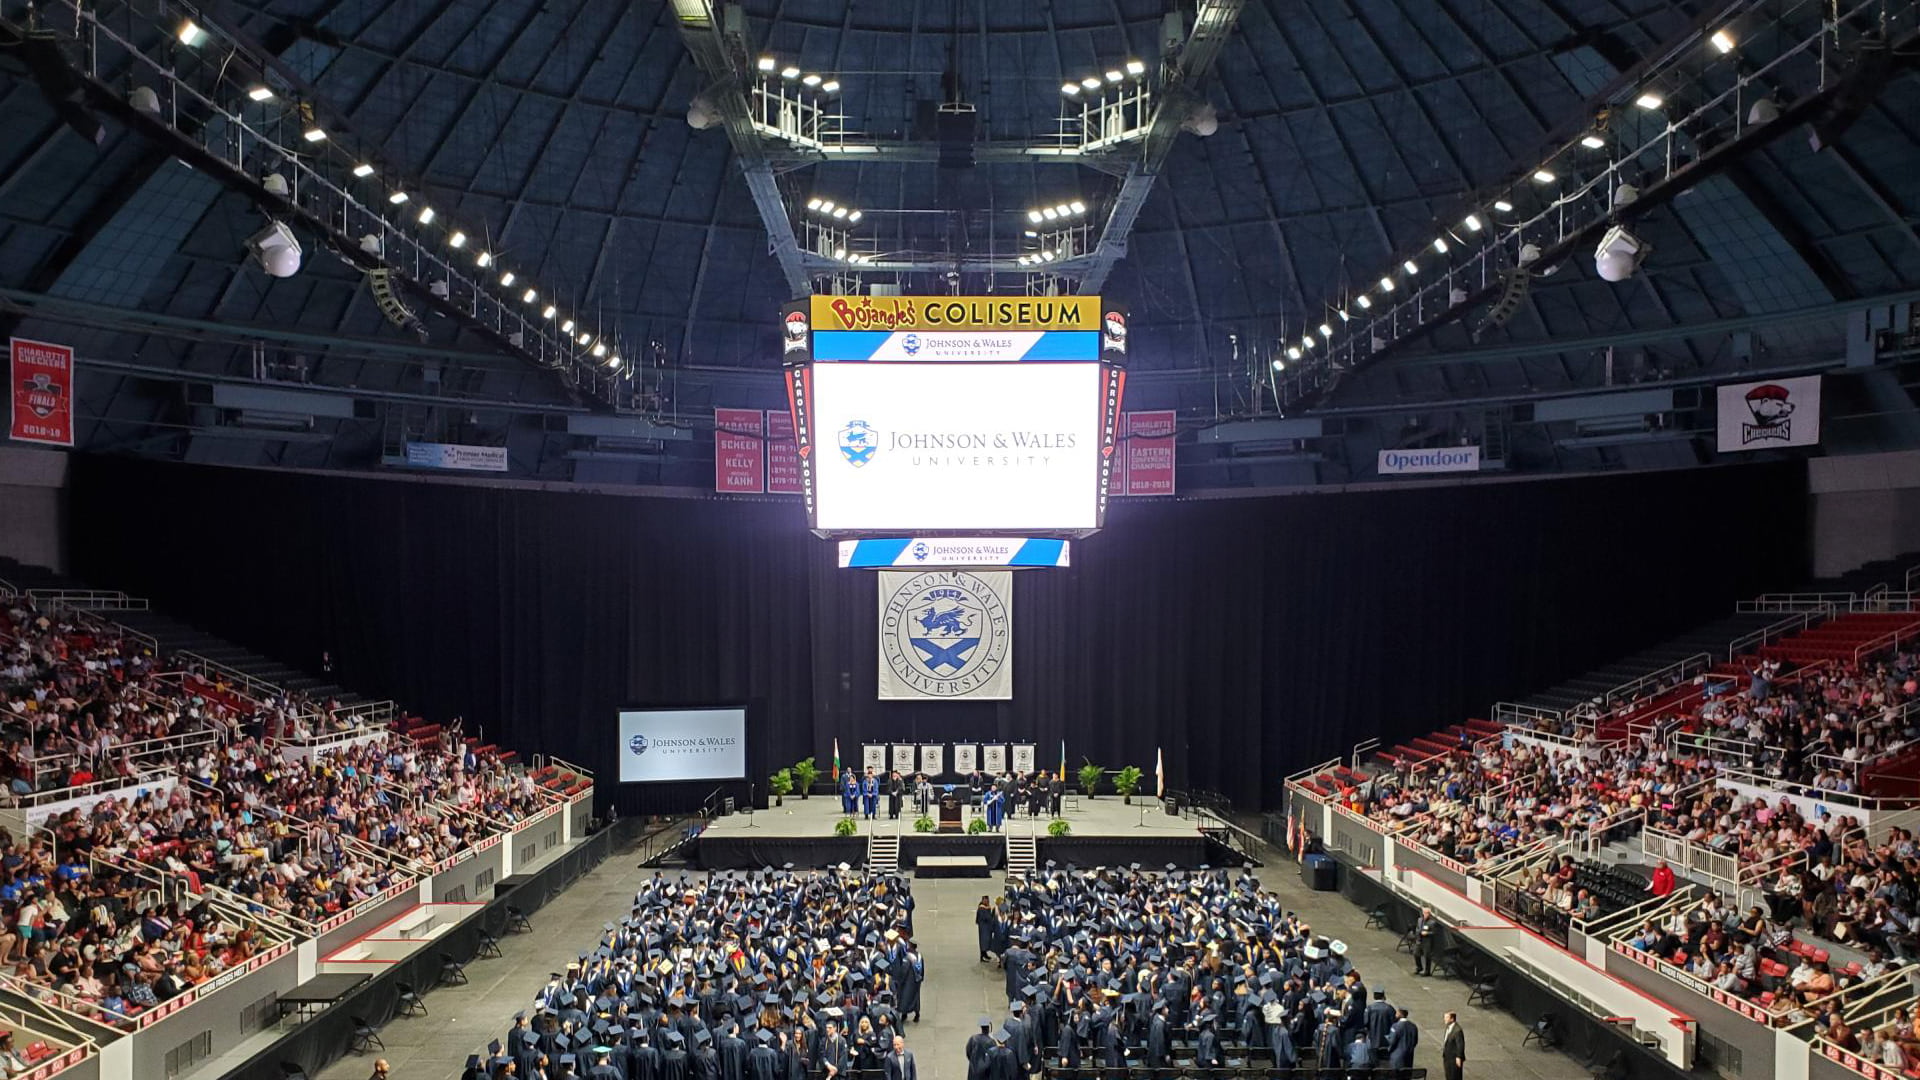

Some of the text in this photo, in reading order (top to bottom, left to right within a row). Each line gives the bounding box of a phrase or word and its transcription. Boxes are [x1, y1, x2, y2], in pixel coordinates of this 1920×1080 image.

[924, 302, 1081, 324] COLISEUM
[926, 338, 1012, 349] JOHNSON & WALES
[18, 346, 66, 360] CHARLOTTE
[18, 355, 66, 369] CHECKERS
[29, 393, 56, 406] FINALS
[794, 369, 808, 444] CAROLINA
[1105, 369, 1118, 444] CAROLINA
[889, 431, 1077, 451] JOHNSON & WALES
[912, 456, 1051, 466] UNIVERSITY
[1131, 448, 1171, 457] EASTERN
[1385, 451, 1472, 470] Opendoor
[725, 459, 754, 468] KELLY
[727, 477, 753, 486] KAHN
[802, 460, 813, 514] HOCKEY
[1100, 460, 1110, 513] HOCKEY
[933, 546, 975, 556] JOHNSON
[983, 546, 1009, 554] WALES
[885, 573, 949, 637] JOHNSON
[971, 581, 1006, 637] WALES
[892, 654, 999, 693] UNIVERSITY
[652, 739, 696, 748] JOHNSON
[706, 737, 736, 746] WALES
[200, 966, 245, 996] WHERE FRIENDS MEET
[1676, 971, 1695, 989] FRIENDS
